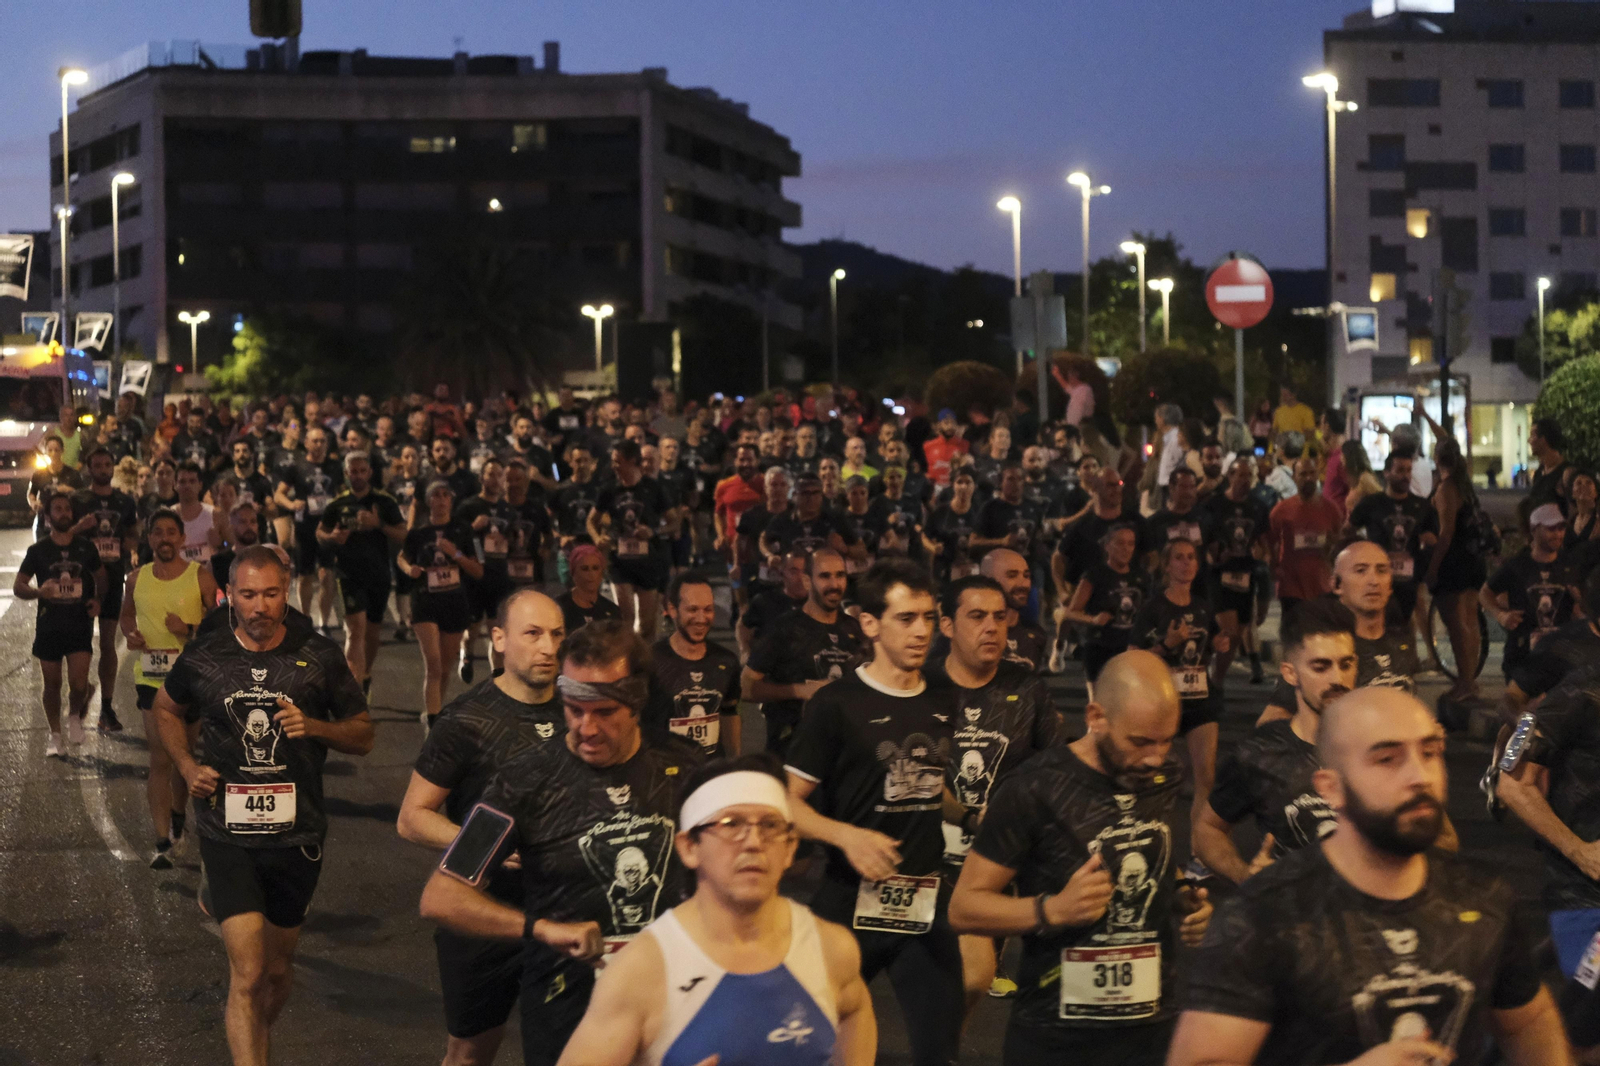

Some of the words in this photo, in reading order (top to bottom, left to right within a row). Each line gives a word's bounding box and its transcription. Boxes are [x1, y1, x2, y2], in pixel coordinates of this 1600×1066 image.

[150, 654, 169, 665] 354
[686, 725, 708, 739] 491
[245, 795, 276, 812] 443
[880, 886, 917, 907] 533
[1093, 962, 1133, 988] 318
